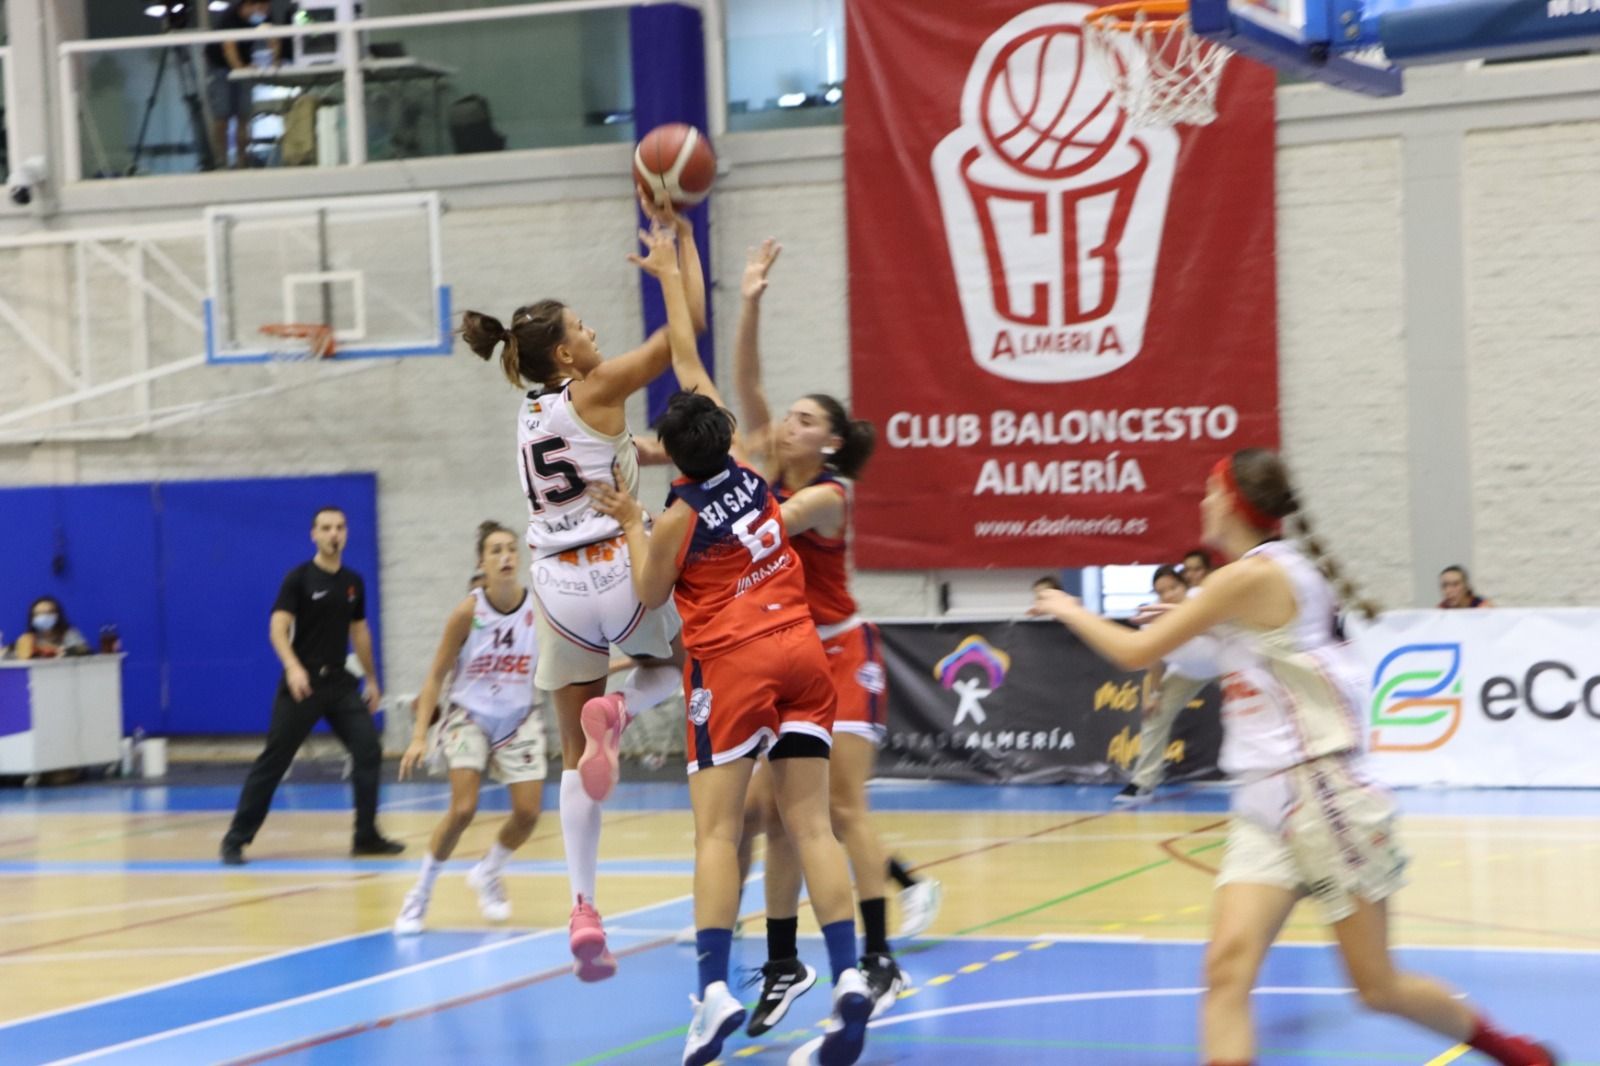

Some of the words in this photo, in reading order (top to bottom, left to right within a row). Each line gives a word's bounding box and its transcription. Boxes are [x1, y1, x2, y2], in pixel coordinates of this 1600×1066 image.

[887, 412, 982, 448] CLUB
[991, 405, 1238, 446] BALONCESTO
[522, 435, 587, 512] 15
[974, 451, 1146, 496] ALMERÍA
[699, 501, 729, 530] BEA
[493, 627, 514, 648] 14
